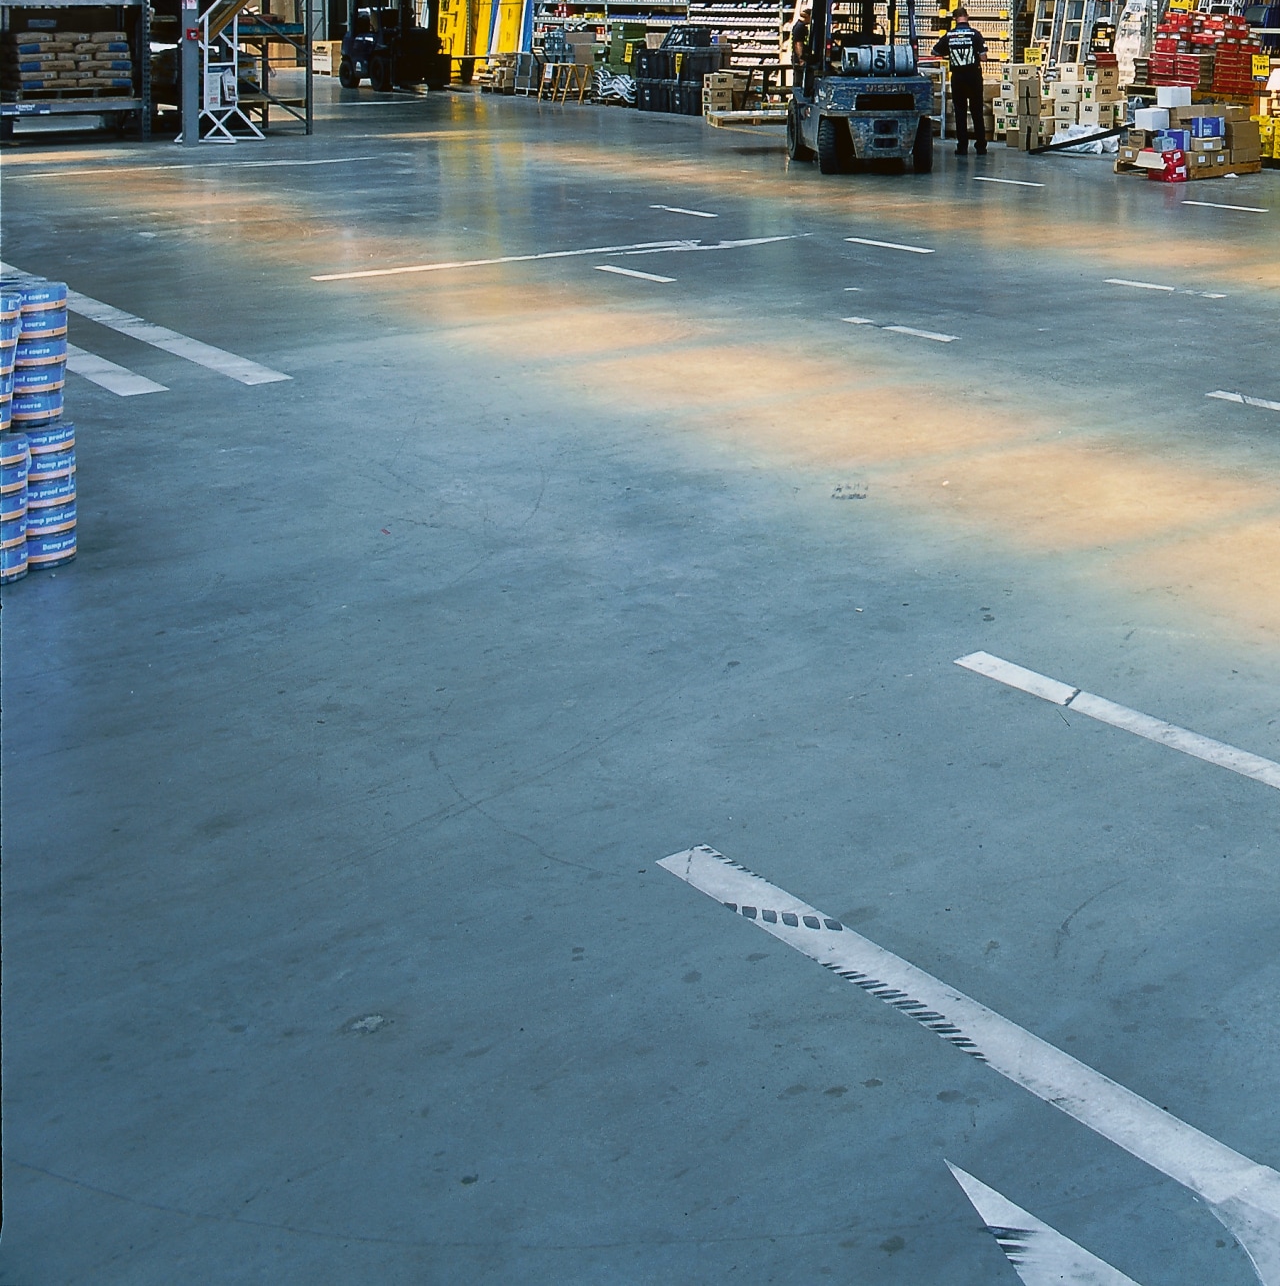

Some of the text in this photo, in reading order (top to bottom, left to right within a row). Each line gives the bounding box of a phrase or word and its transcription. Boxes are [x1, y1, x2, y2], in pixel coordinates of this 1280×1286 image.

[866, 84, 906, 92] NISSAN
[37, 462, 56, 470] Damp
[43, 542, 62, 551] Damp
